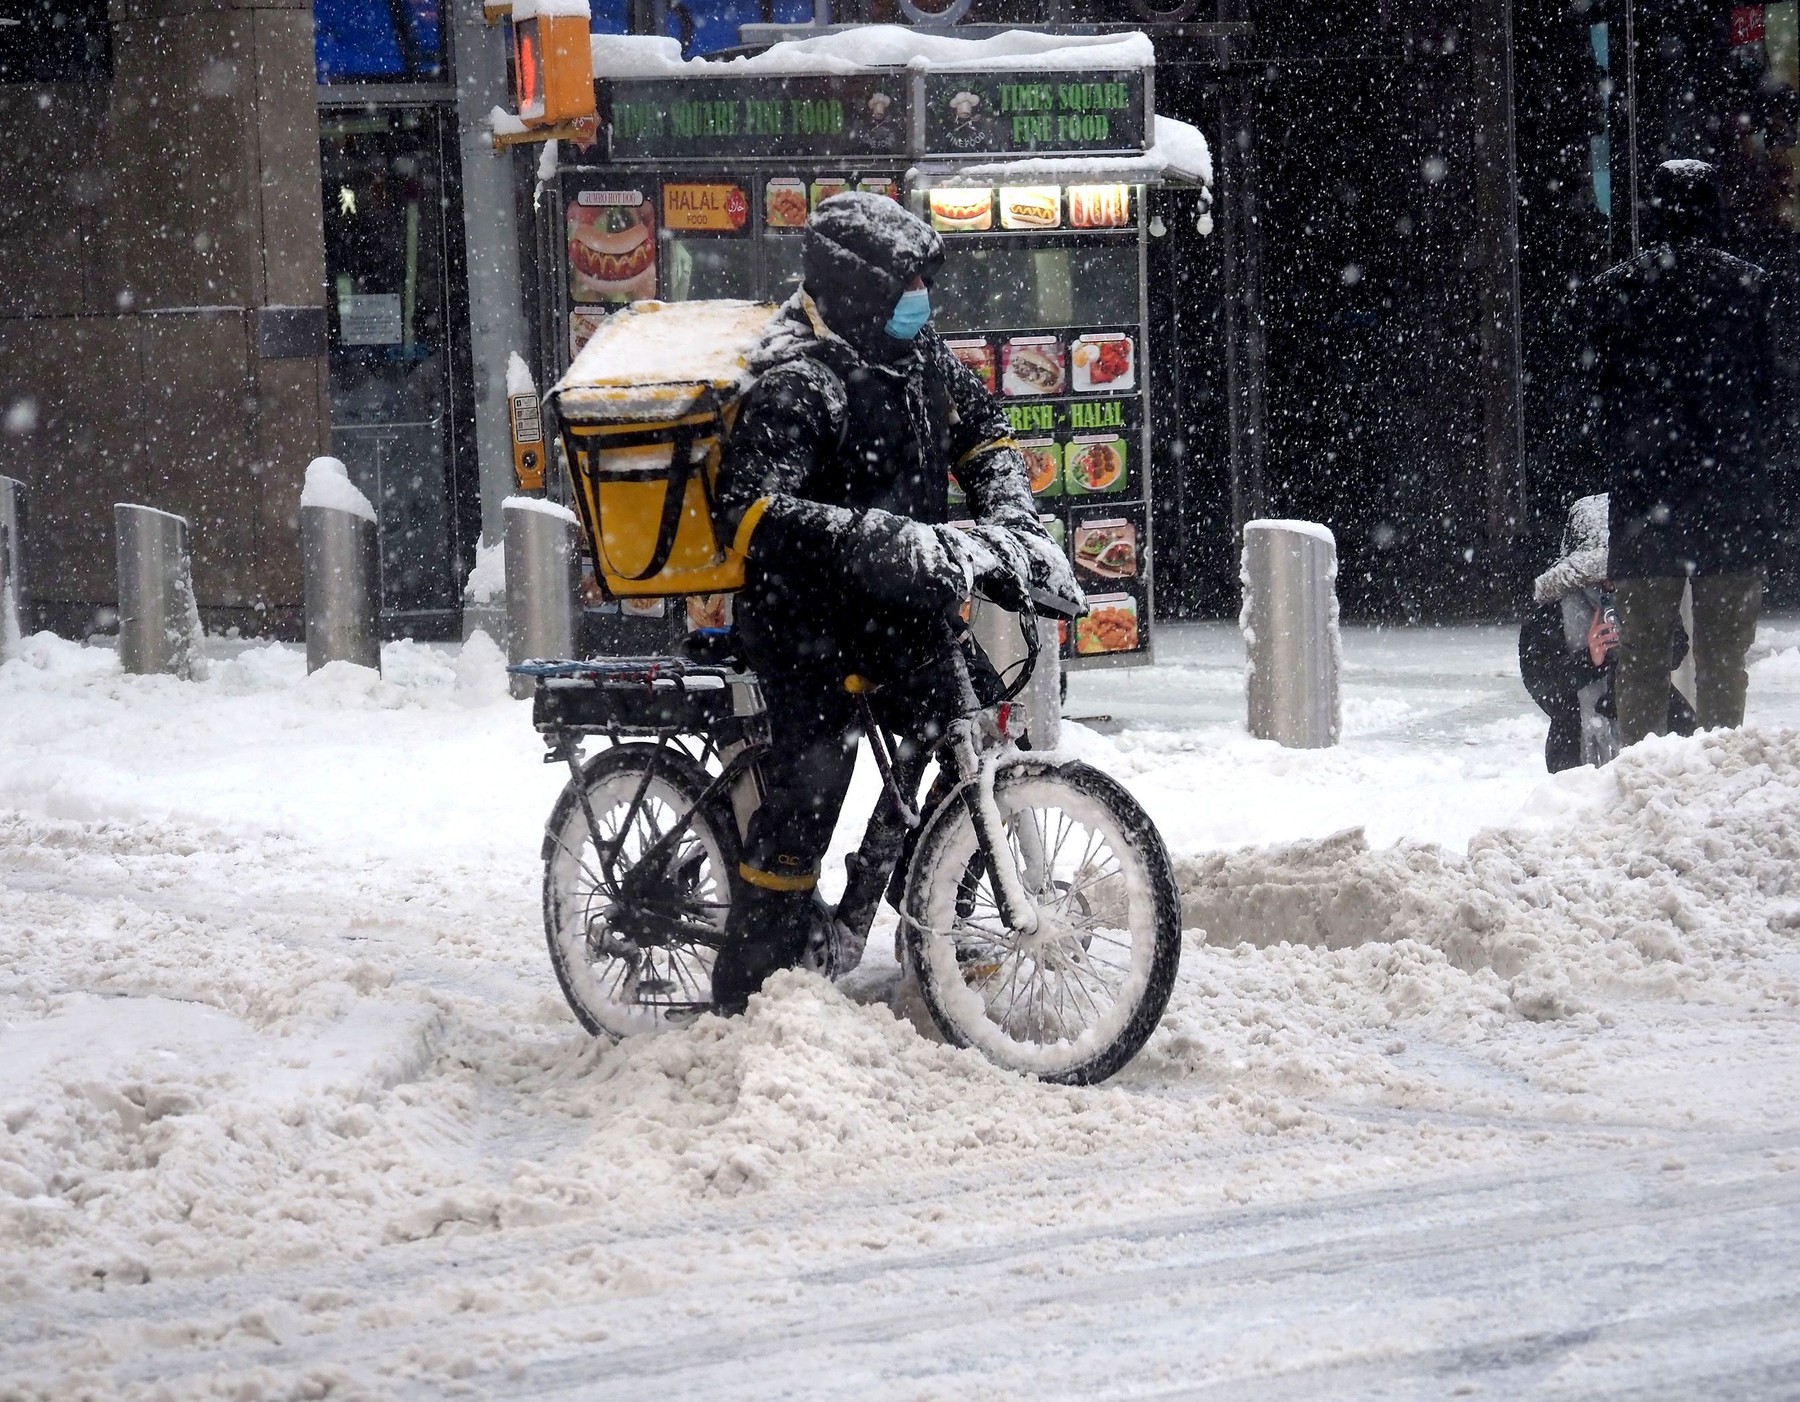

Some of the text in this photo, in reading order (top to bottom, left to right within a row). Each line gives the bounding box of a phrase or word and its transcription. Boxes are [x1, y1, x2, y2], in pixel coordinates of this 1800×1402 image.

[1000, 83, 1052, 111] TIMES
[1058, 82, 1129, 109] SQUARE
[670, 101, 738, 137] SQUARE
[746, 100, 784, 135] FINE
[792, 99, 843, 135] FOOD
[1012, 115, 1110, 142] FINE FOOD
[609, 193, 621, 204] HOT
[622, 193, 636, 204] DOG
[669, 190, 719, 211] HALAL
[687, 215, 708, 225] FOOD
[1070, 402, 1123, 428] HALAL
